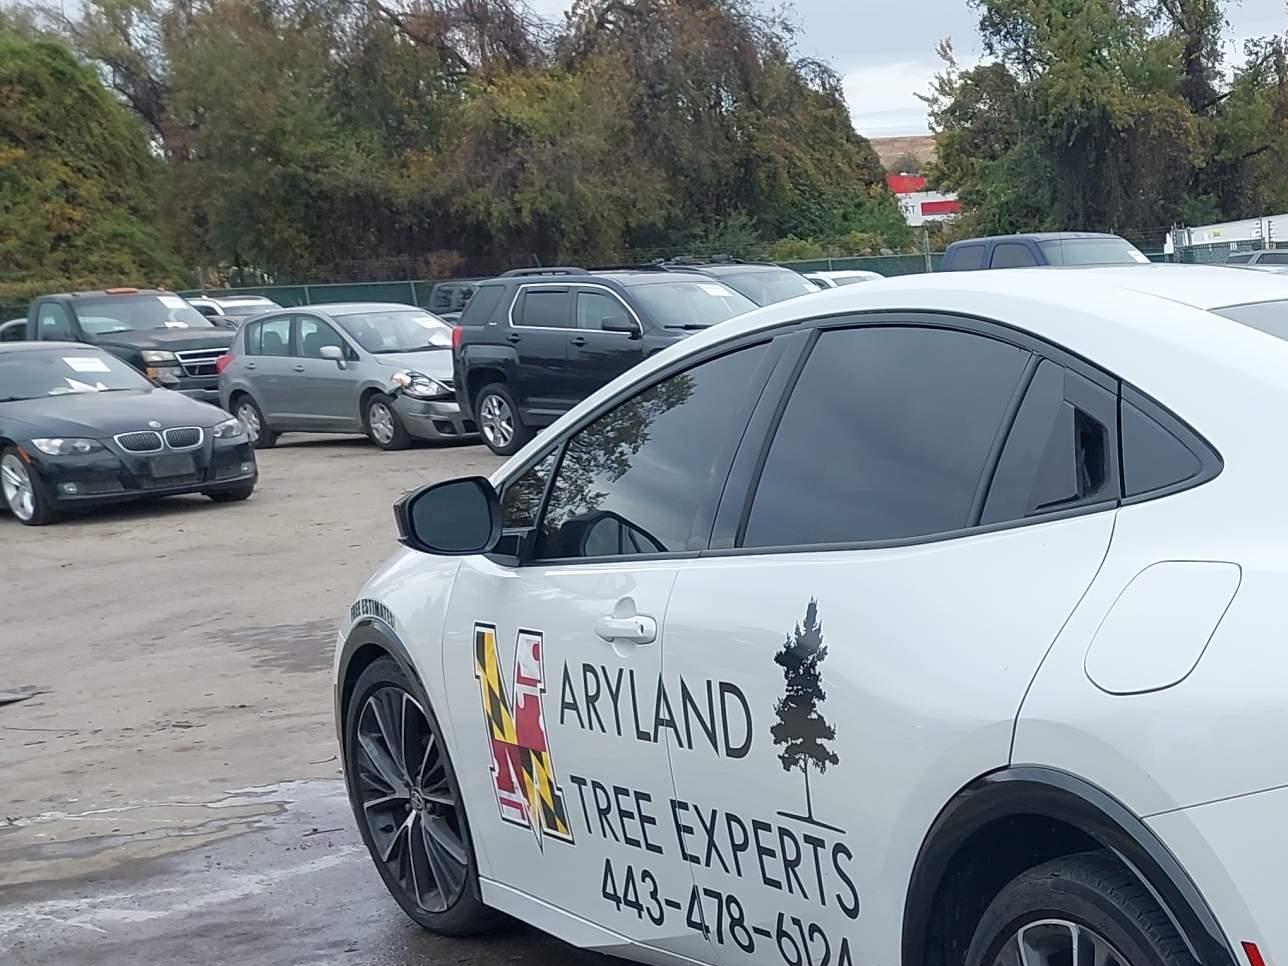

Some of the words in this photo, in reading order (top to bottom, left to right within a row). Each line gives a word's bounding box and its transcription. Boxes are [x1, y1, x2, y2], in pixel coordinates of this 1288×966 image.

[351, 600, 361, 621] FREE
[569, 775, 664, 855] TREE
[669, 798, 861, 920] EXPERTS
